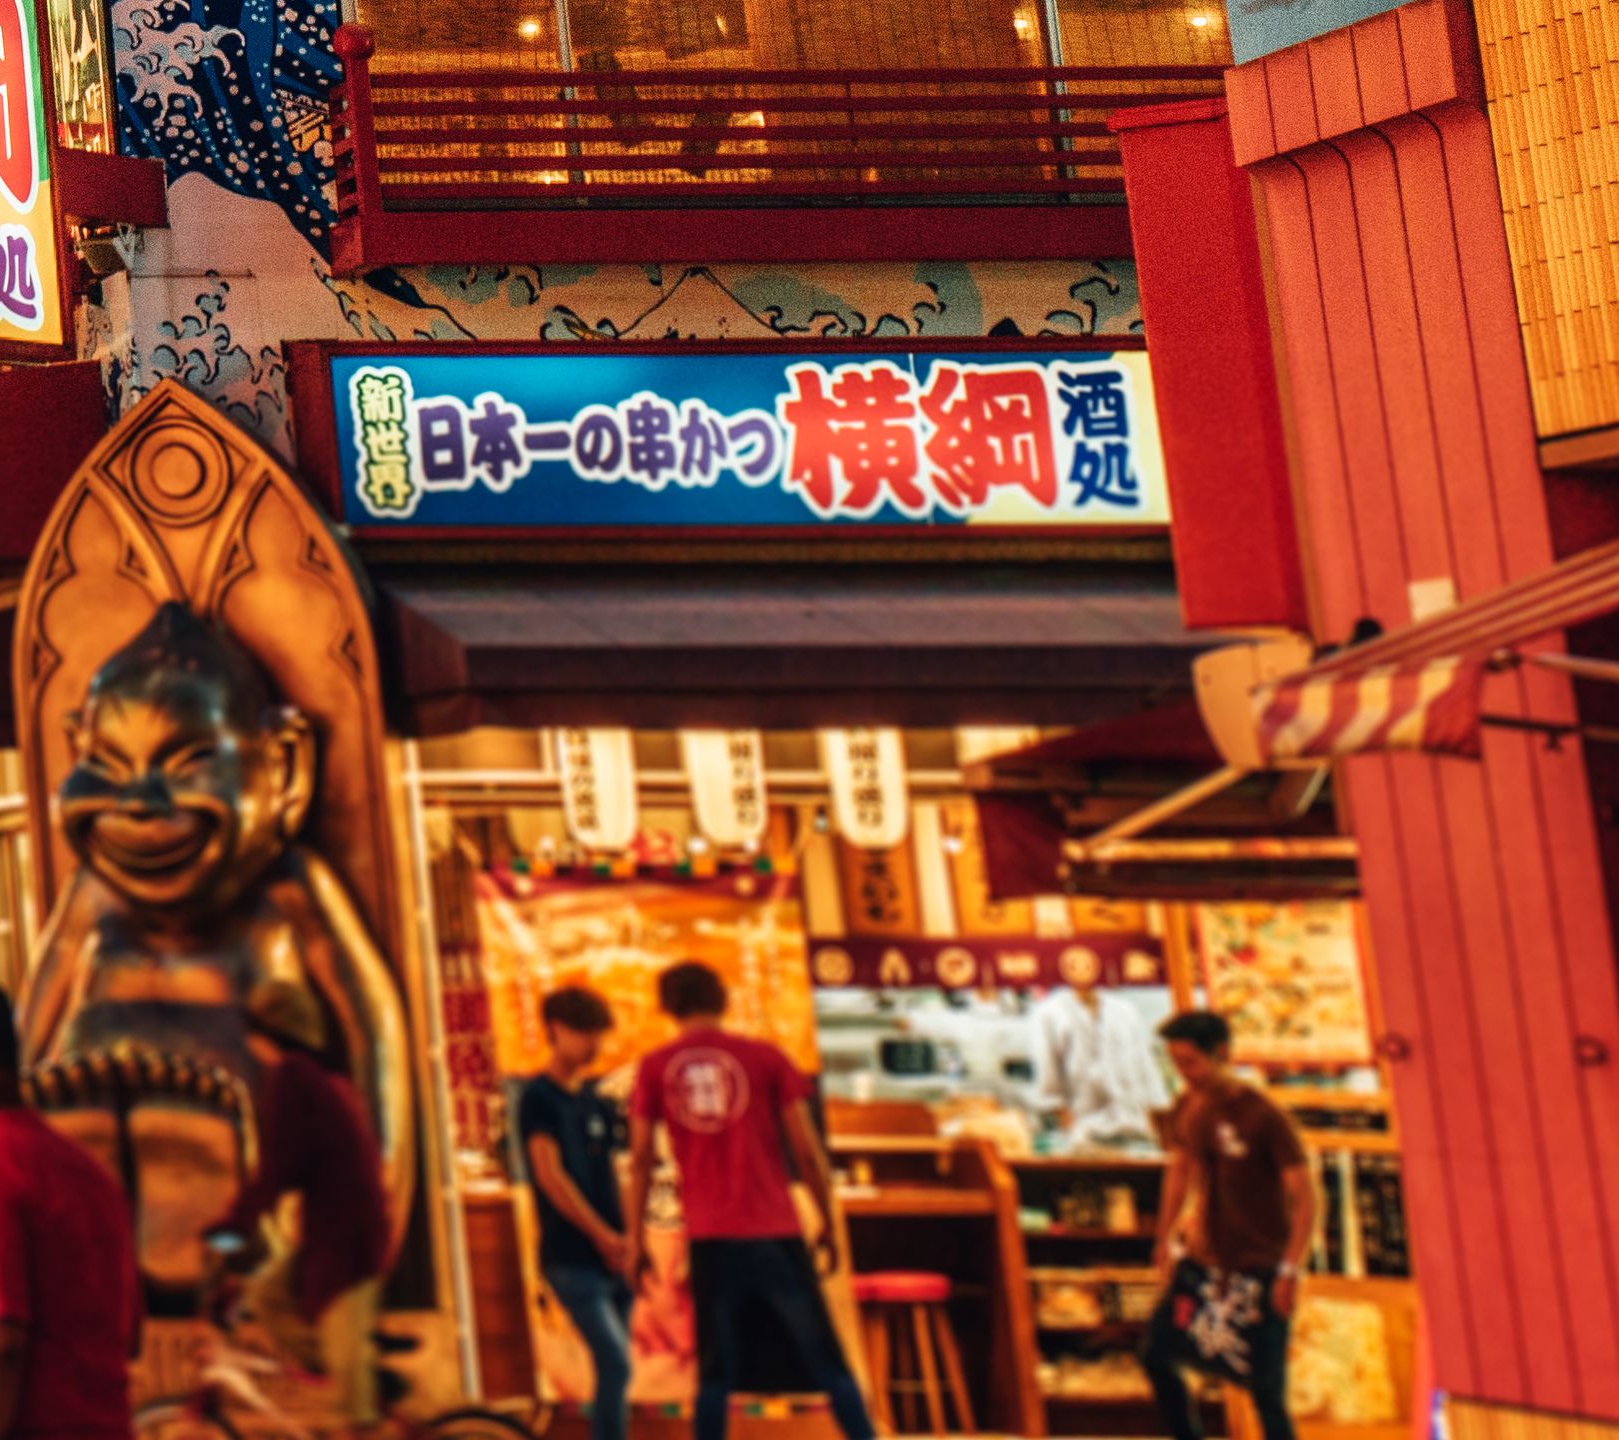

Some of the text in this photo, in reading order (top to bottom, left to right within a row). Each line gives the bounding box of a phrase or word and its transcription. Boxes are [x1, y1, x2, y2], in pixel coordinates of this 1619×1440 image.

[352, 367, 412, 515] 新世界
[415, 365, 1064, 517] 日本一の串かつ 横綱
[1058, 363, 1139, 509] 酒処
